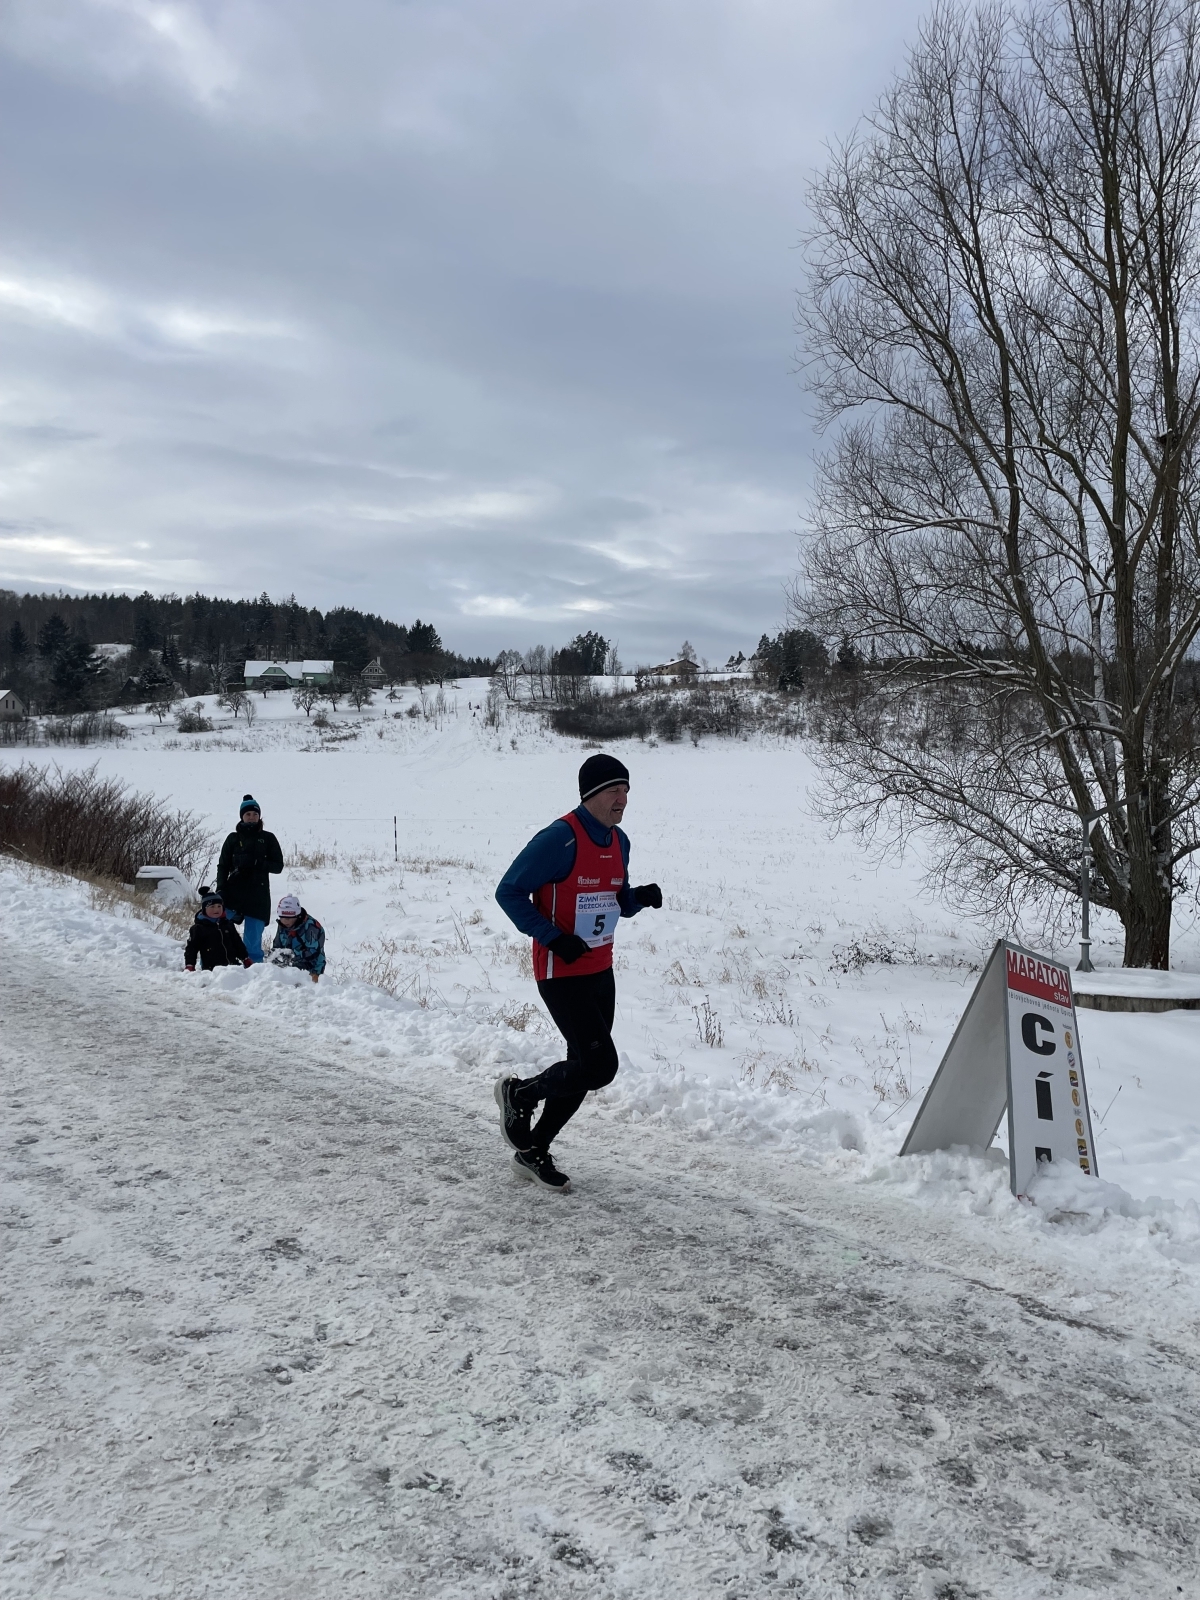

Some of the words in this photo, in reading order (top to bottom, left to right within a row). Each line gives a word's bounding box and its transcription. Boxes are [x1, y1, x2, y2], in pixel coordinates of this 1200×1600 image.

[592, 915, 605, 936] 5
[1006, 949, 1069, 992] MARATON
[1053, 992, 1069, 1004] stav
